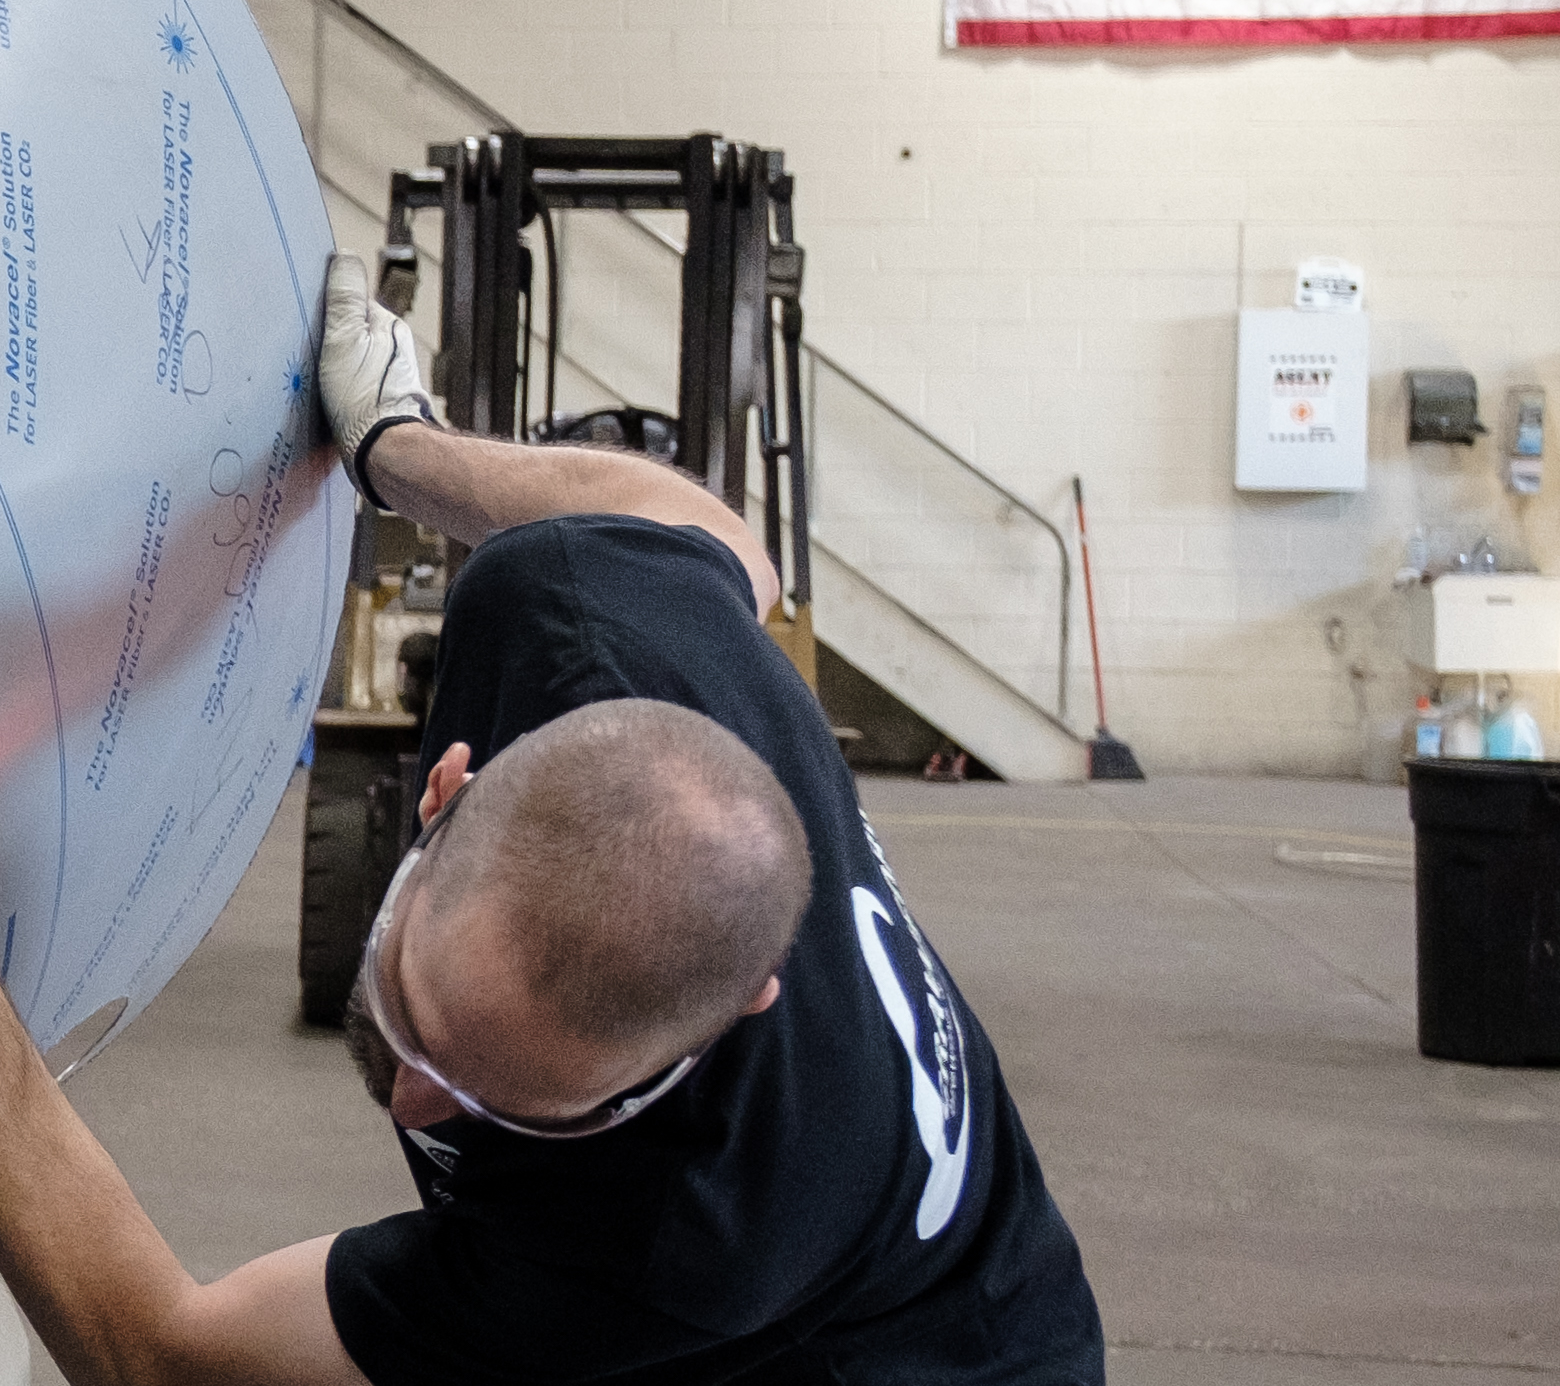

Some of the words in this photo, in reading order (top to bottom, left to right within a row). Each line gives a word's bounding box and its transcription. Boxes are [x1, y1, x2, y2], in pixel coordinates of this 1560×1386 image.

[0, 131, 20, 232] Solution
[21, 184, 36, 253] LASER
[25, 274, 37, 331] Fiber
[25, 337, 37, 408] LASER
[7, 390, 20, 434] The
[23, 412, 35, 445] for
